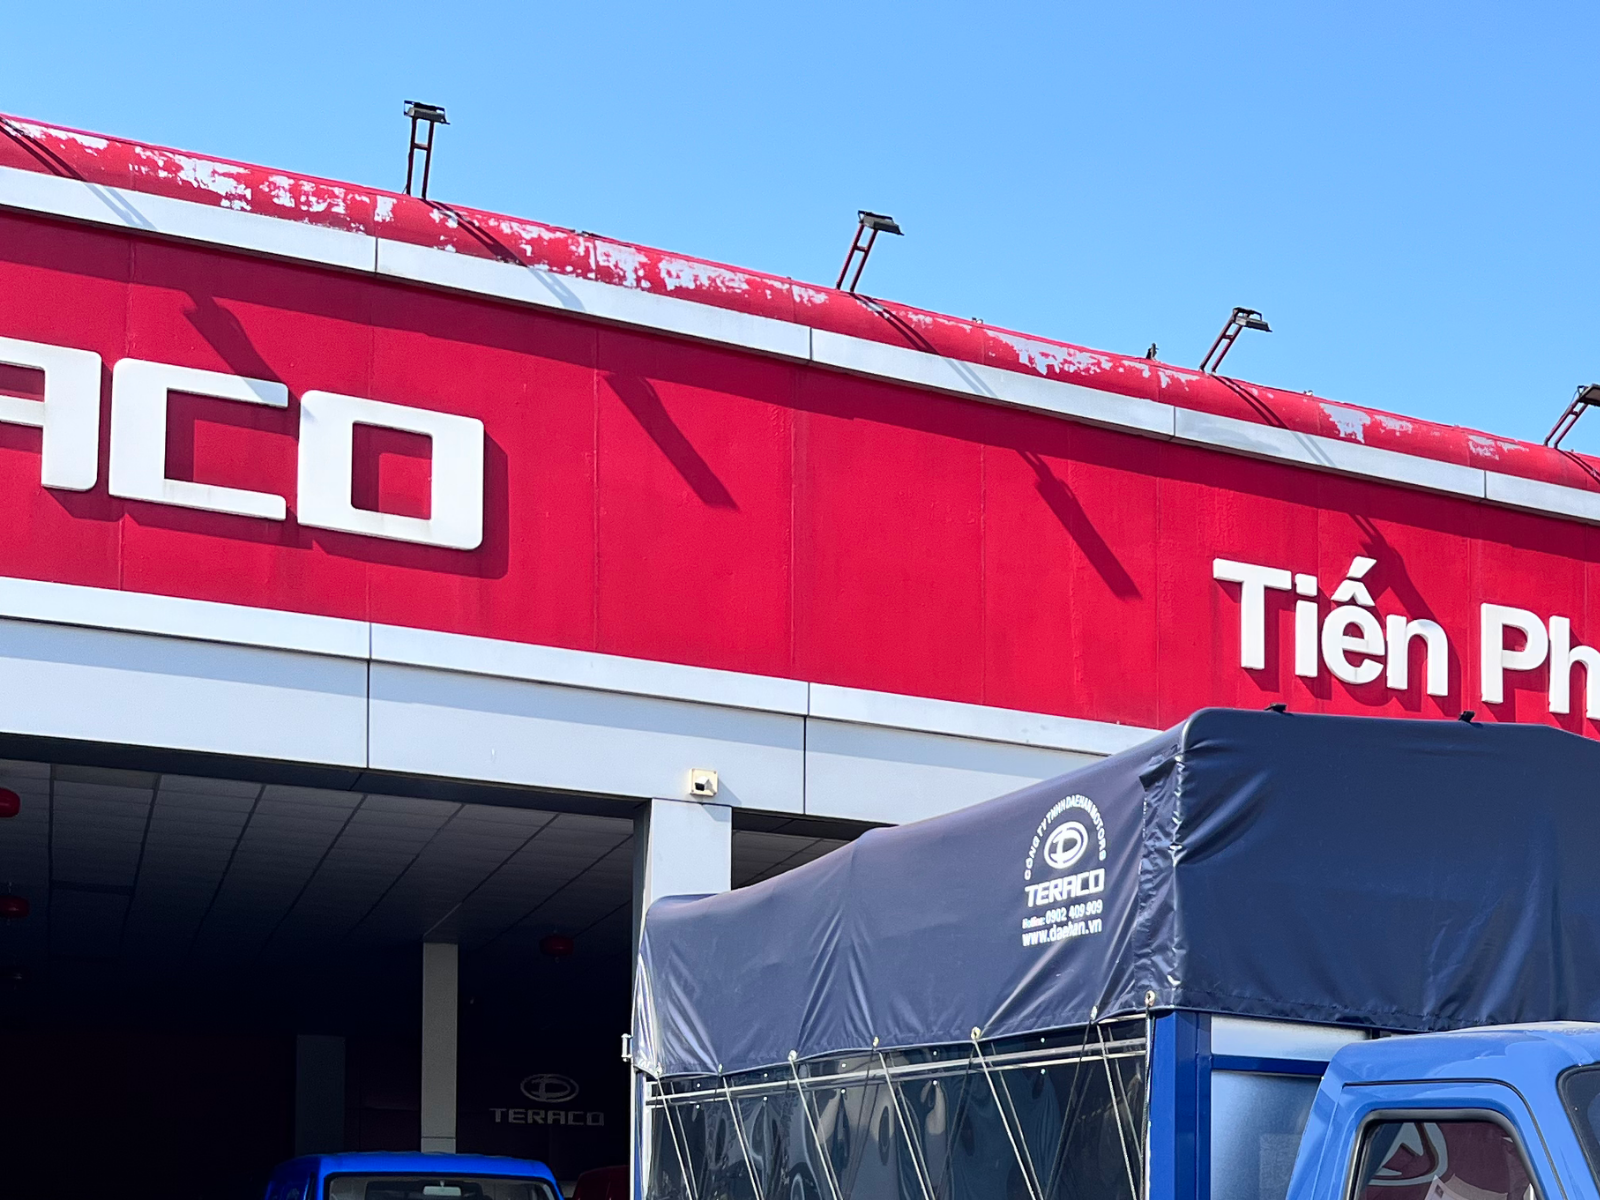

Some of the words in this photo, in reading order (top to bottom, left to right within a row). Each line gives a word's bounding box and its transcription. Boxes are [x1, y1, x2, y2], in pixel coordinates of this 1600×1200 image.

[1212, 555, 1448, 697] Tiến
[1024, 868, 1105, 907] TERACO
[1045, 907, 1067, 924] 0902
[1069, 903, 1085, 919] 409
[1086, 899, 1103, 916] 909
[1022, 918, 1102, 946] www.daehan.vn
[489, 1108, 604, 1126] TERACO
